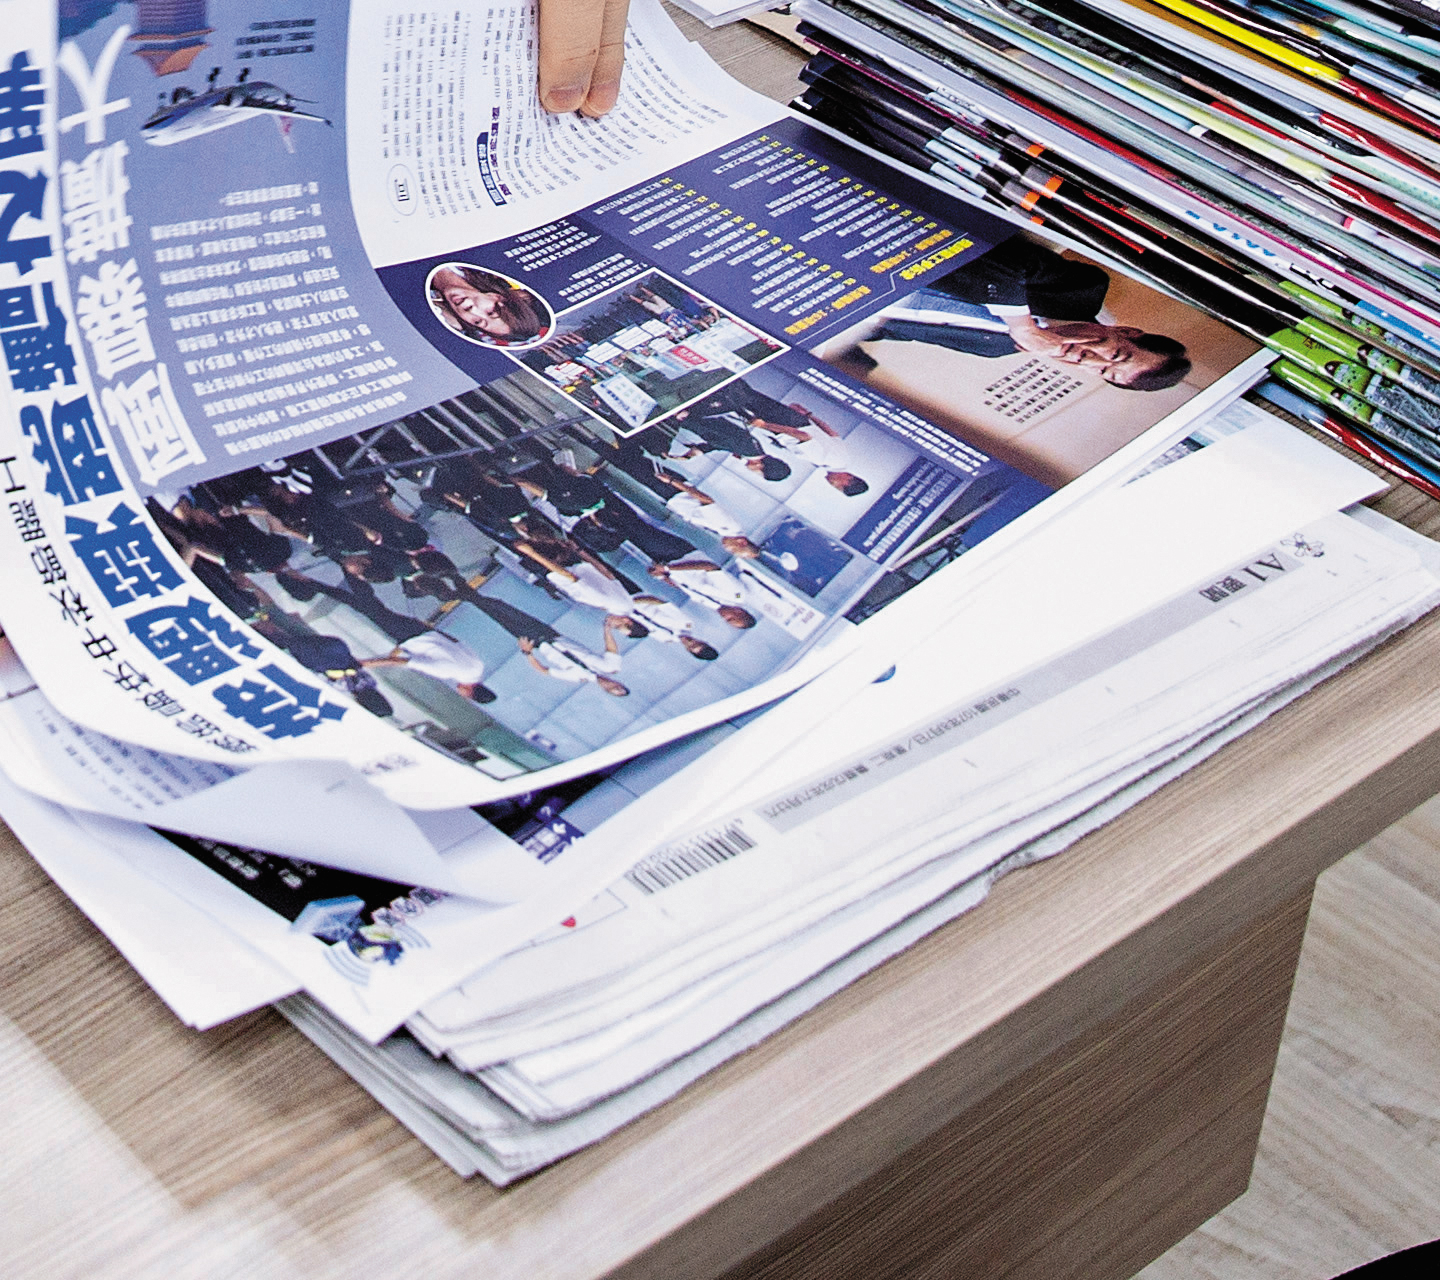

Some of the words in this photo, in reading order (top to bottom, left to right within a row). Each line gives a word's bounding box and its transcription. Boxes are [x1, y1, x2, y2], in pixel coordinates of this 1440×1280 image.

[56, 24, 206, 485] 風暴擴大
[1243, 551, 1287, 585] A1
[1197, 577, 1247, 603] 要聞
